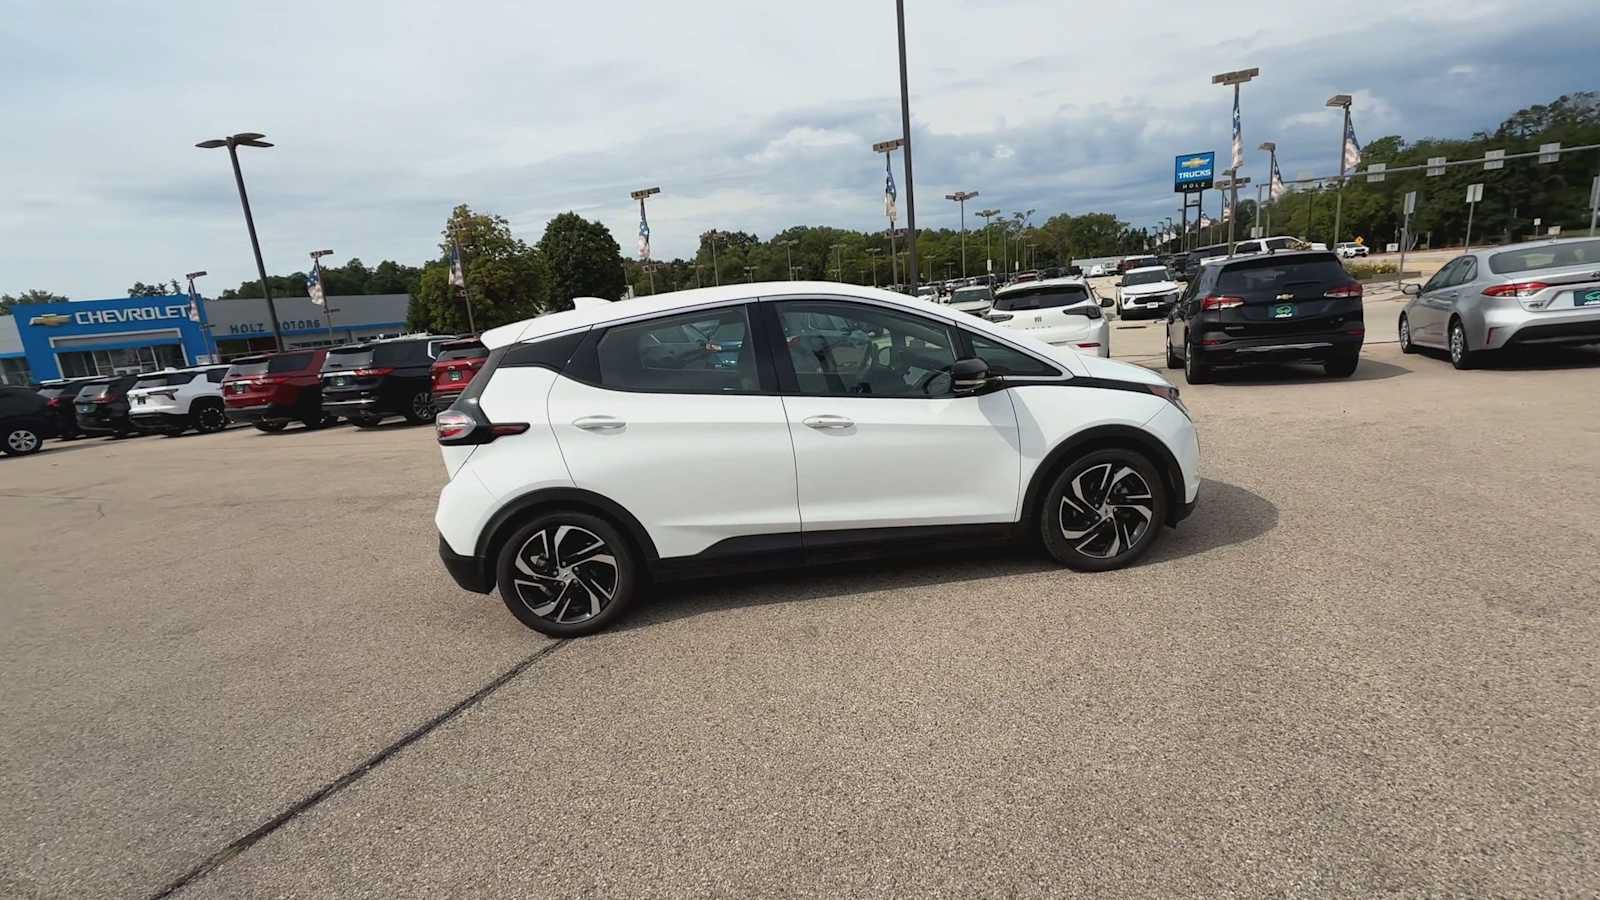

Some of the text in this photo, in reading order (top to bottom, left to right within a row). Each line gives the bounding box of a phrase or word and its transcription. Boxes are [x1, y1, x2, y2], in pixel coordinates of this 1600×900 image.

[1177, 169, 1211, 179] TRUCKS
[75, 305, 189, 325] CHEVROLET
[230, 319, 320, 334] HOLZ OTORS
